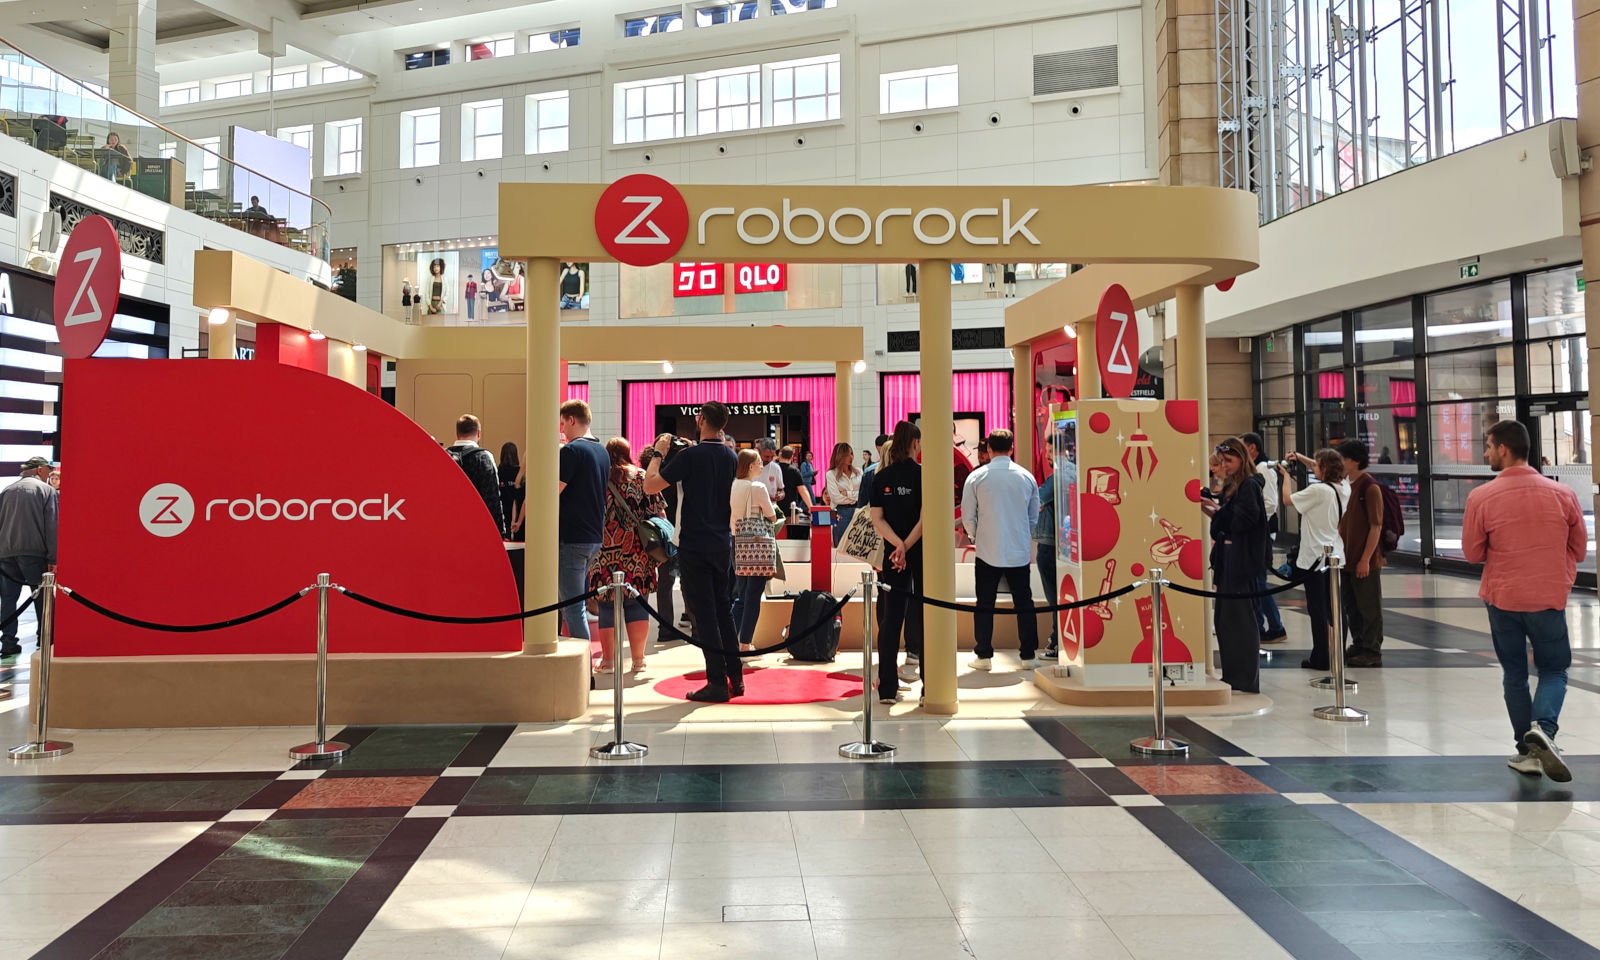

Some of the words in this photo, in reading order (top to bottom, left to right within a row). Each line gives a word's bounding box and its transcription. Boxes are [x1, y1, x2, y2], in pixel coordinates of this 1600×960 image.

[698, 198, 1041, 246] roborock
[739, 264, 780, 290] QLO
[743, 405, 782, 415] SECRET
[206, 493, 406, 522] roborock
[848, 527, 881, 551] CHANGE
